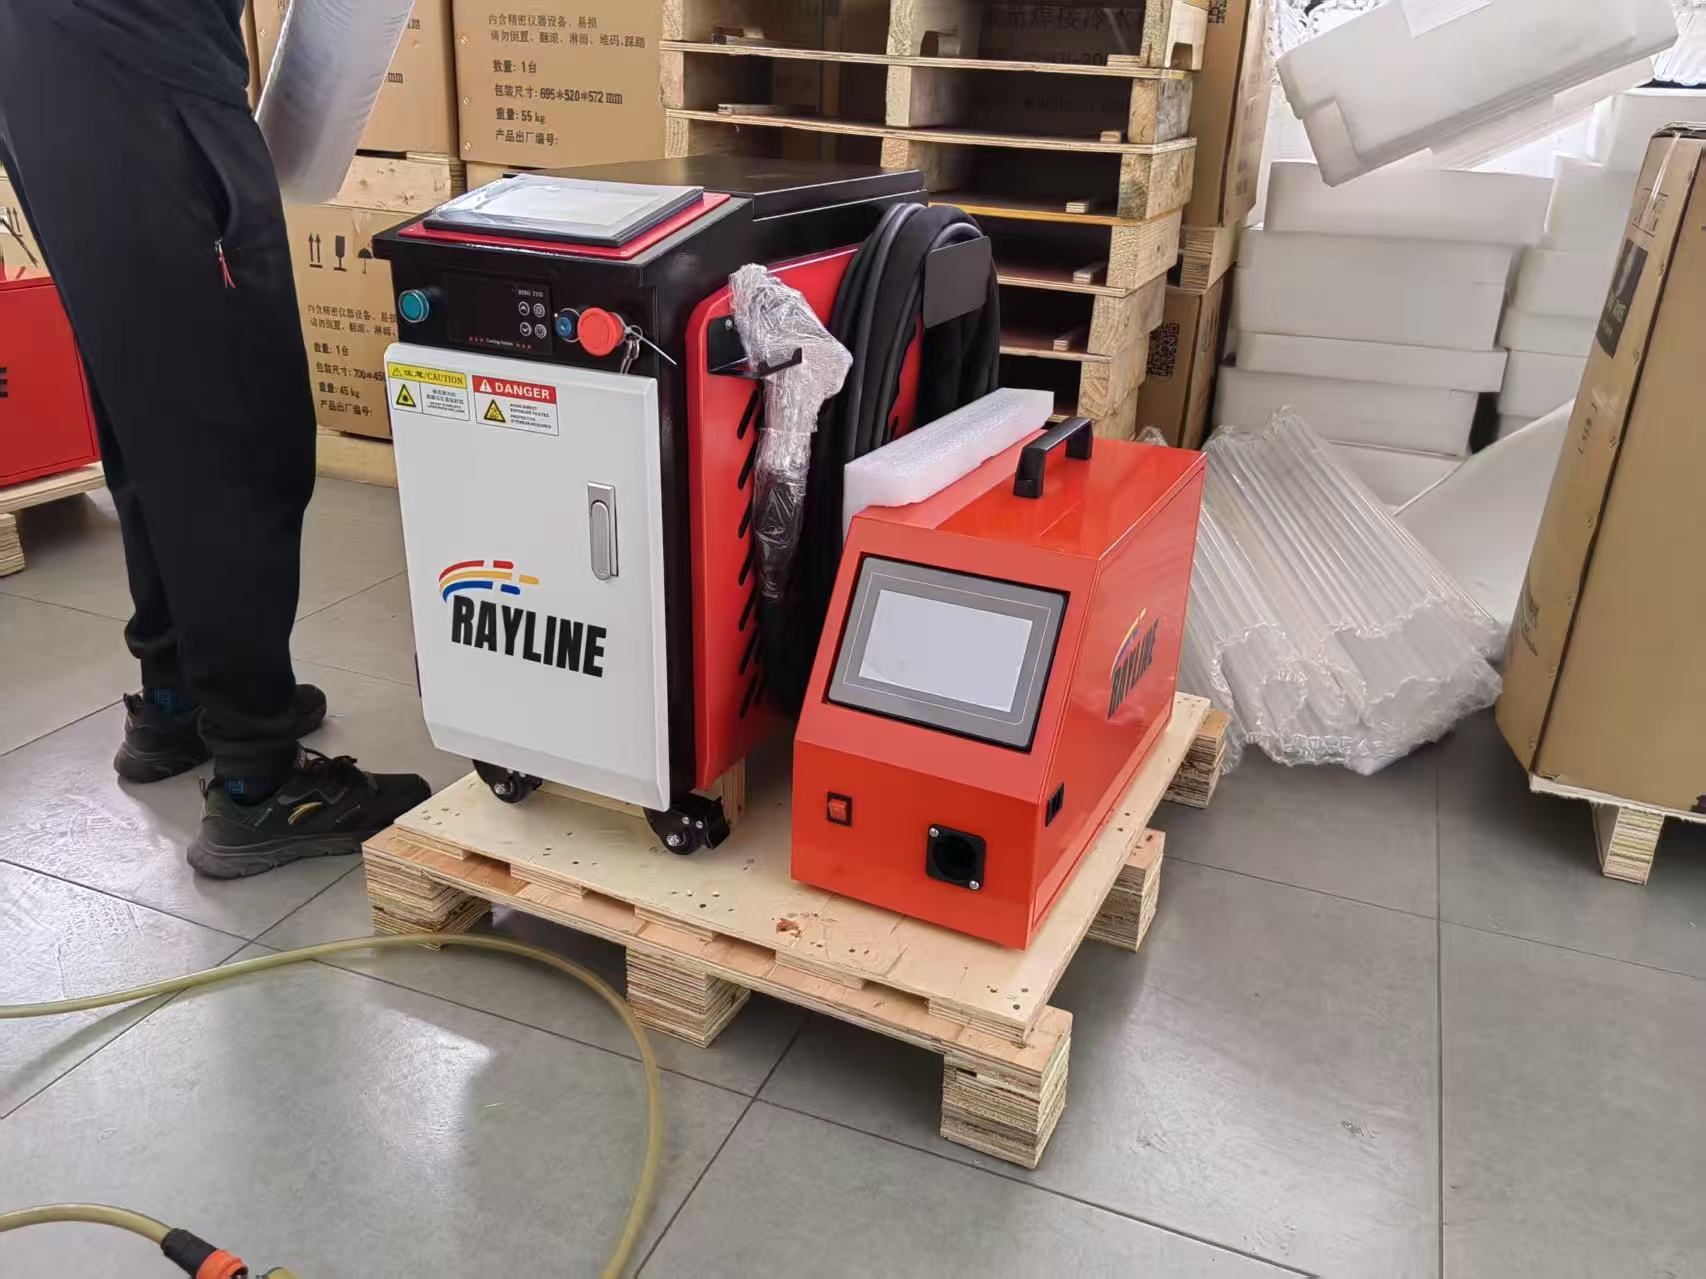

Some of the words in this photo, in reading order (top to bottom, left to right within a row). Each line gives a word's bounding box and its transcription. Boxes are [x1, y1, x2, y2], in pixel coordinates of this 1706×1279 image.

[521, 110, 533, 122] 55
[535, 112, 545, 125] kg
[495, 381, 550, 400] DANGER
[451, 594, 607, 678] RAYLINE
